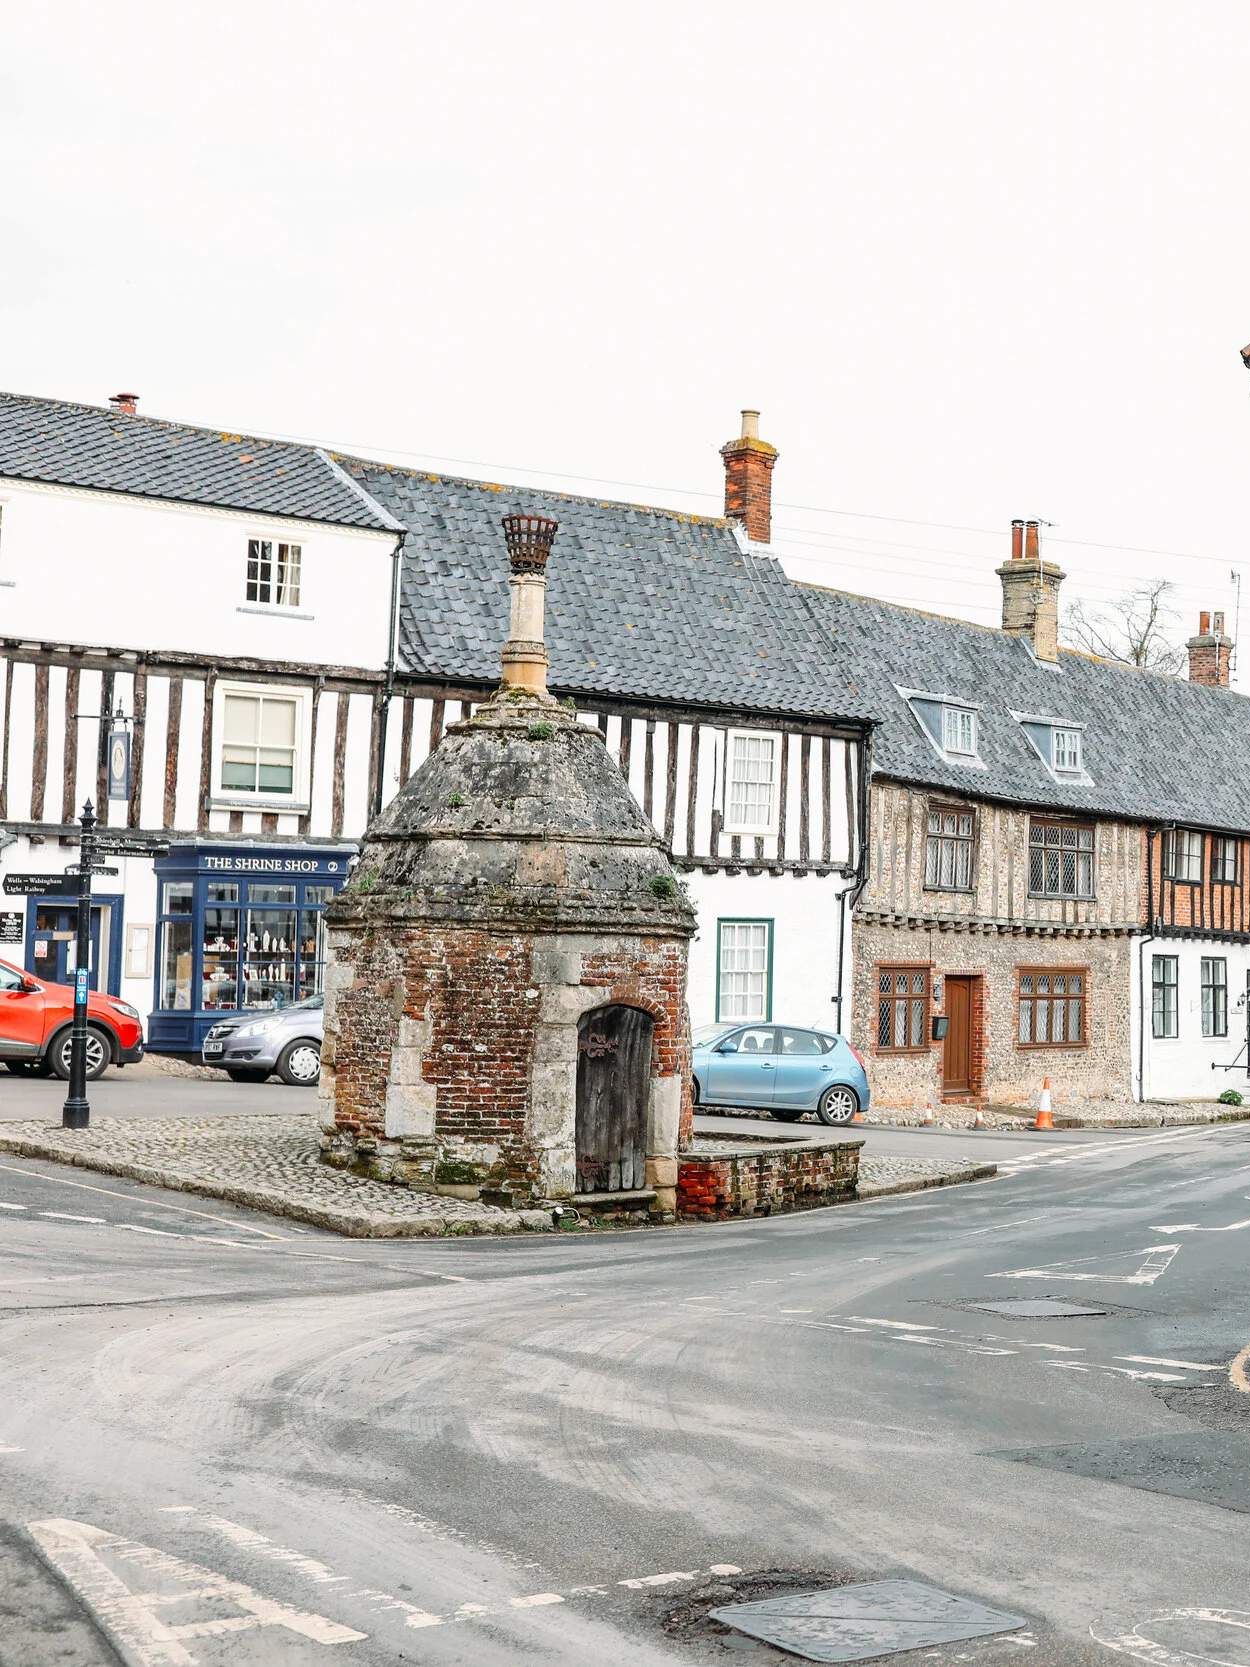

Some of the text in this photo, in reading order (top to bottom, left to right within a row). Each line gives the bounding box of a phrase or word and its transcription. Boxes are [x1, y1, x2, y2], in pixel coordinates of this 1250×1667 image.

[117, 849, 149, 857] Information
[205, 856, 232, 869] THE
[234, 858, 283, 871] SHRINE
[284, 860, 319, 871] SHOP
[29, 877, 62, 886] Walsingham
